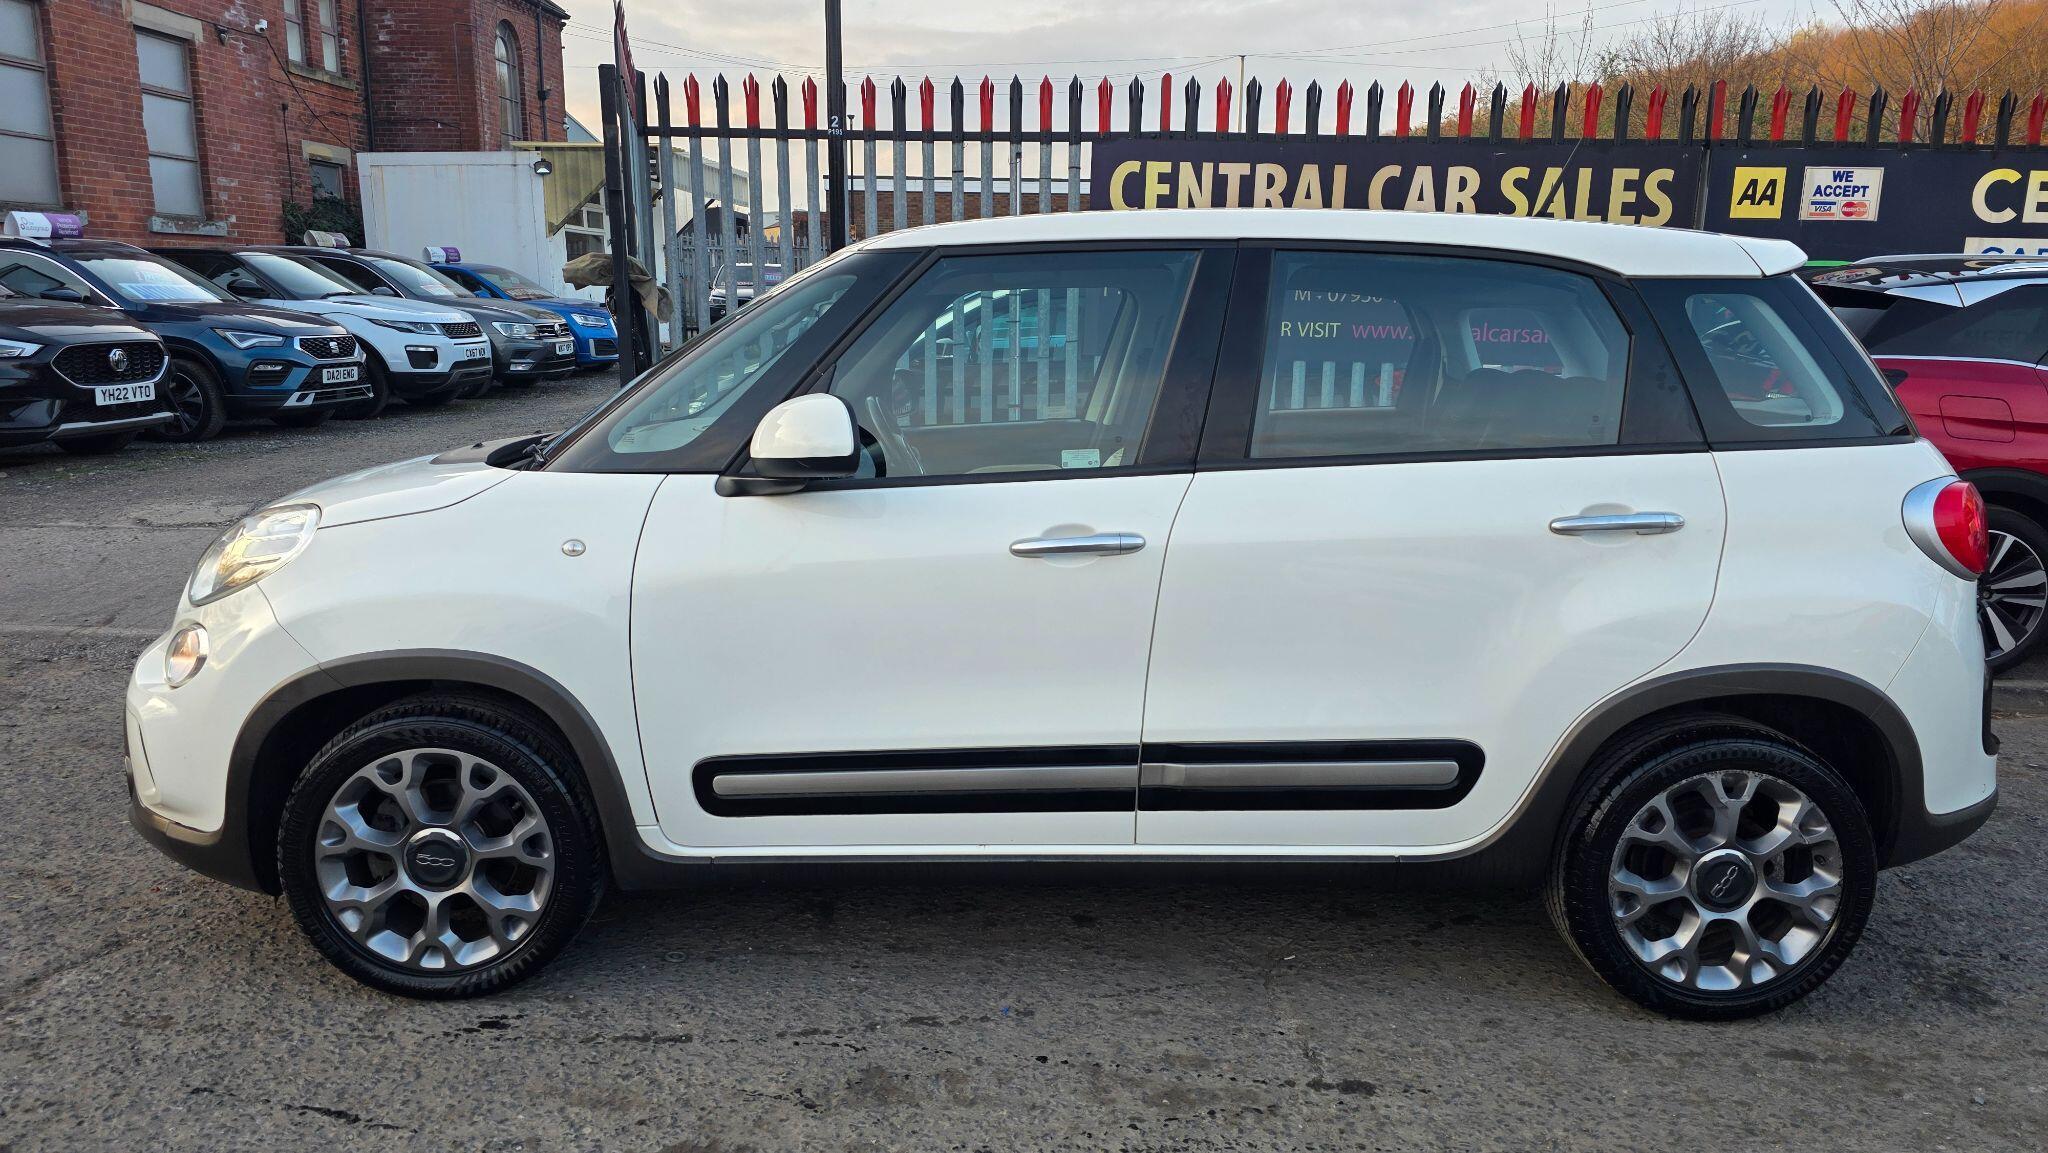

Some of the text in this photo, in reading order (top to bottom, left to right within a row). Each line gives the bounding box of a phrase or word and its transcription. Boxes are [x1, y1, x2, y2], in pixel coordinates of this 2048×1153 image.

[831, 116, 838, 127] 2
[1833, 171, 1854, 182] WE
[1368, 164, 1480, 213] CAR
[1500, 166, 1675, 227] SALES
[1736, 178, 1778, 206] AA
[1813, 185, 1869, 197] ACCEPT
[1298, 321, 1341, 338] VISIT
[101, 385, 151, 402] YH22 VTO
